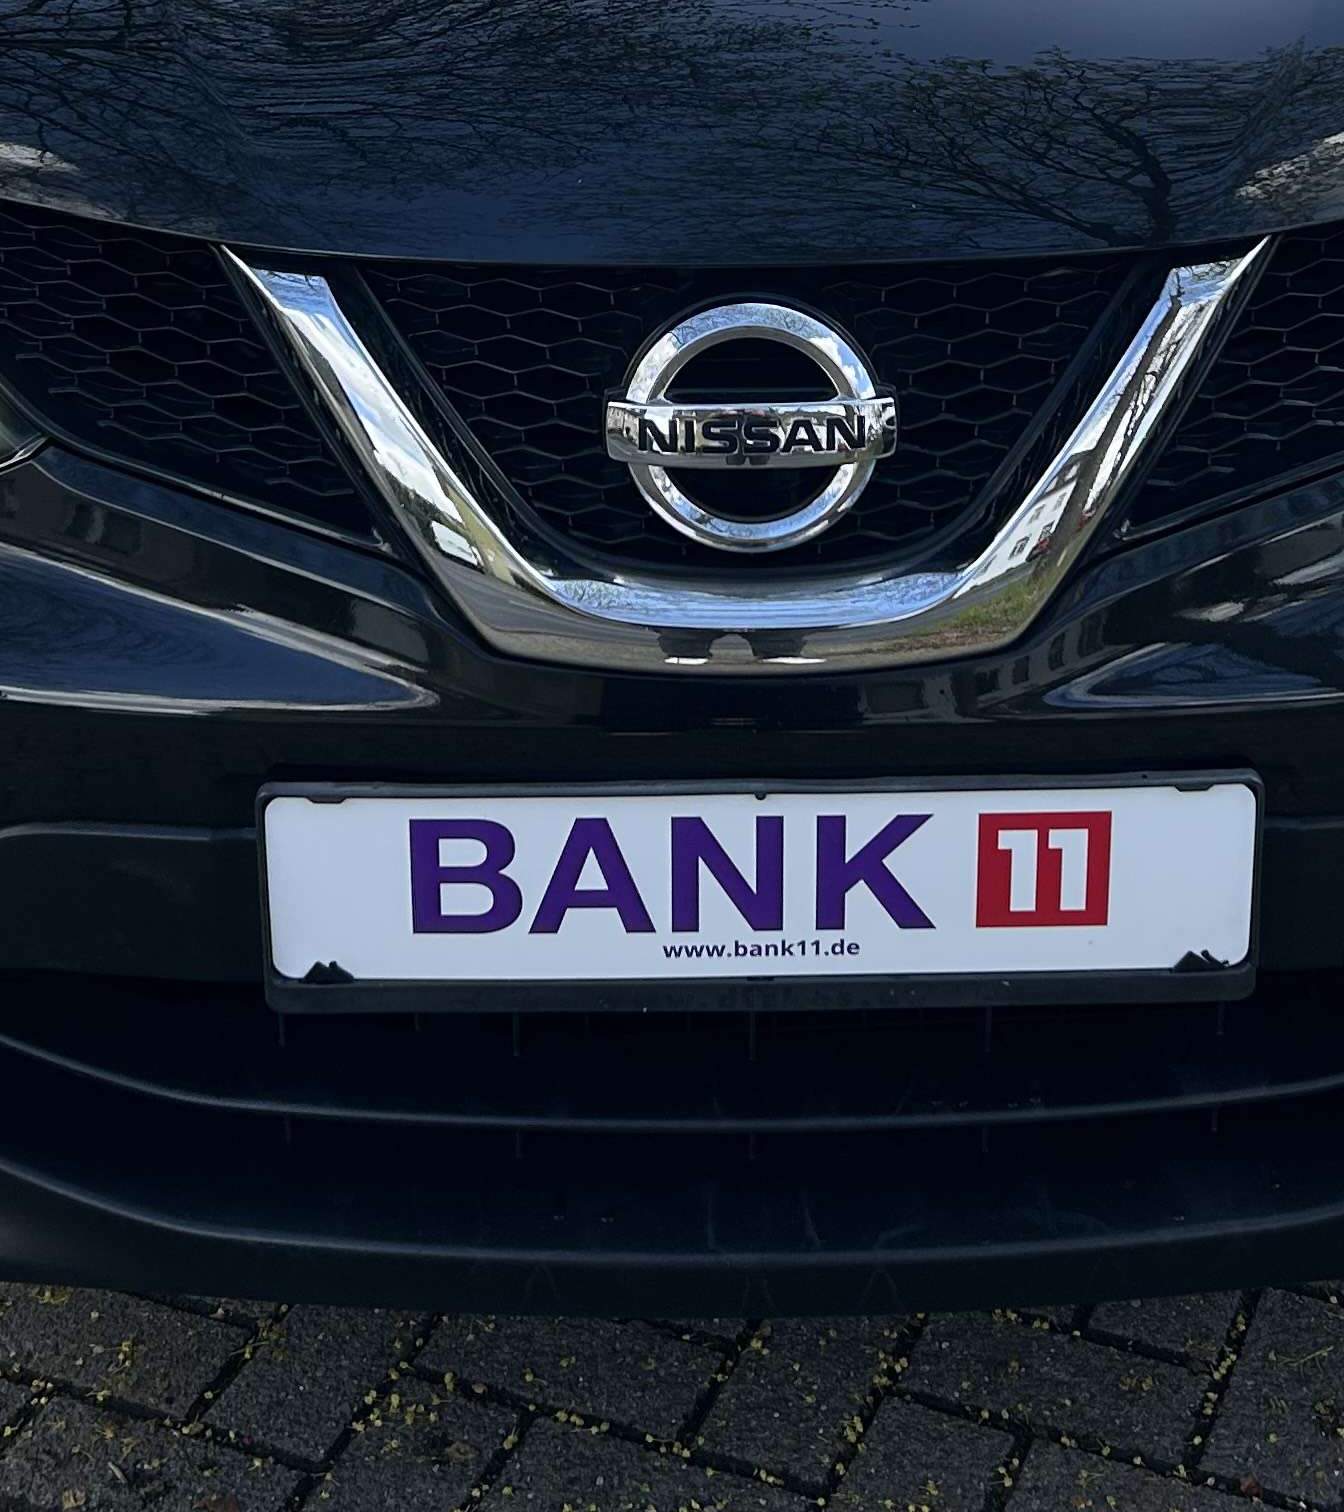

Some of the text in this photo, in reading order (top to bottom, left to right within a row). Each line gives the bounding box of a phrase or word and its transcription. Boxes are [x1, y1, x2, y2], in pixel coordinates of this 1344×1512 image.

[637, 414, 867, 456] NISSAN
[408, 813, 1090, 934] BANK 11
[662, 938, 861, 958] www.bank11.de
